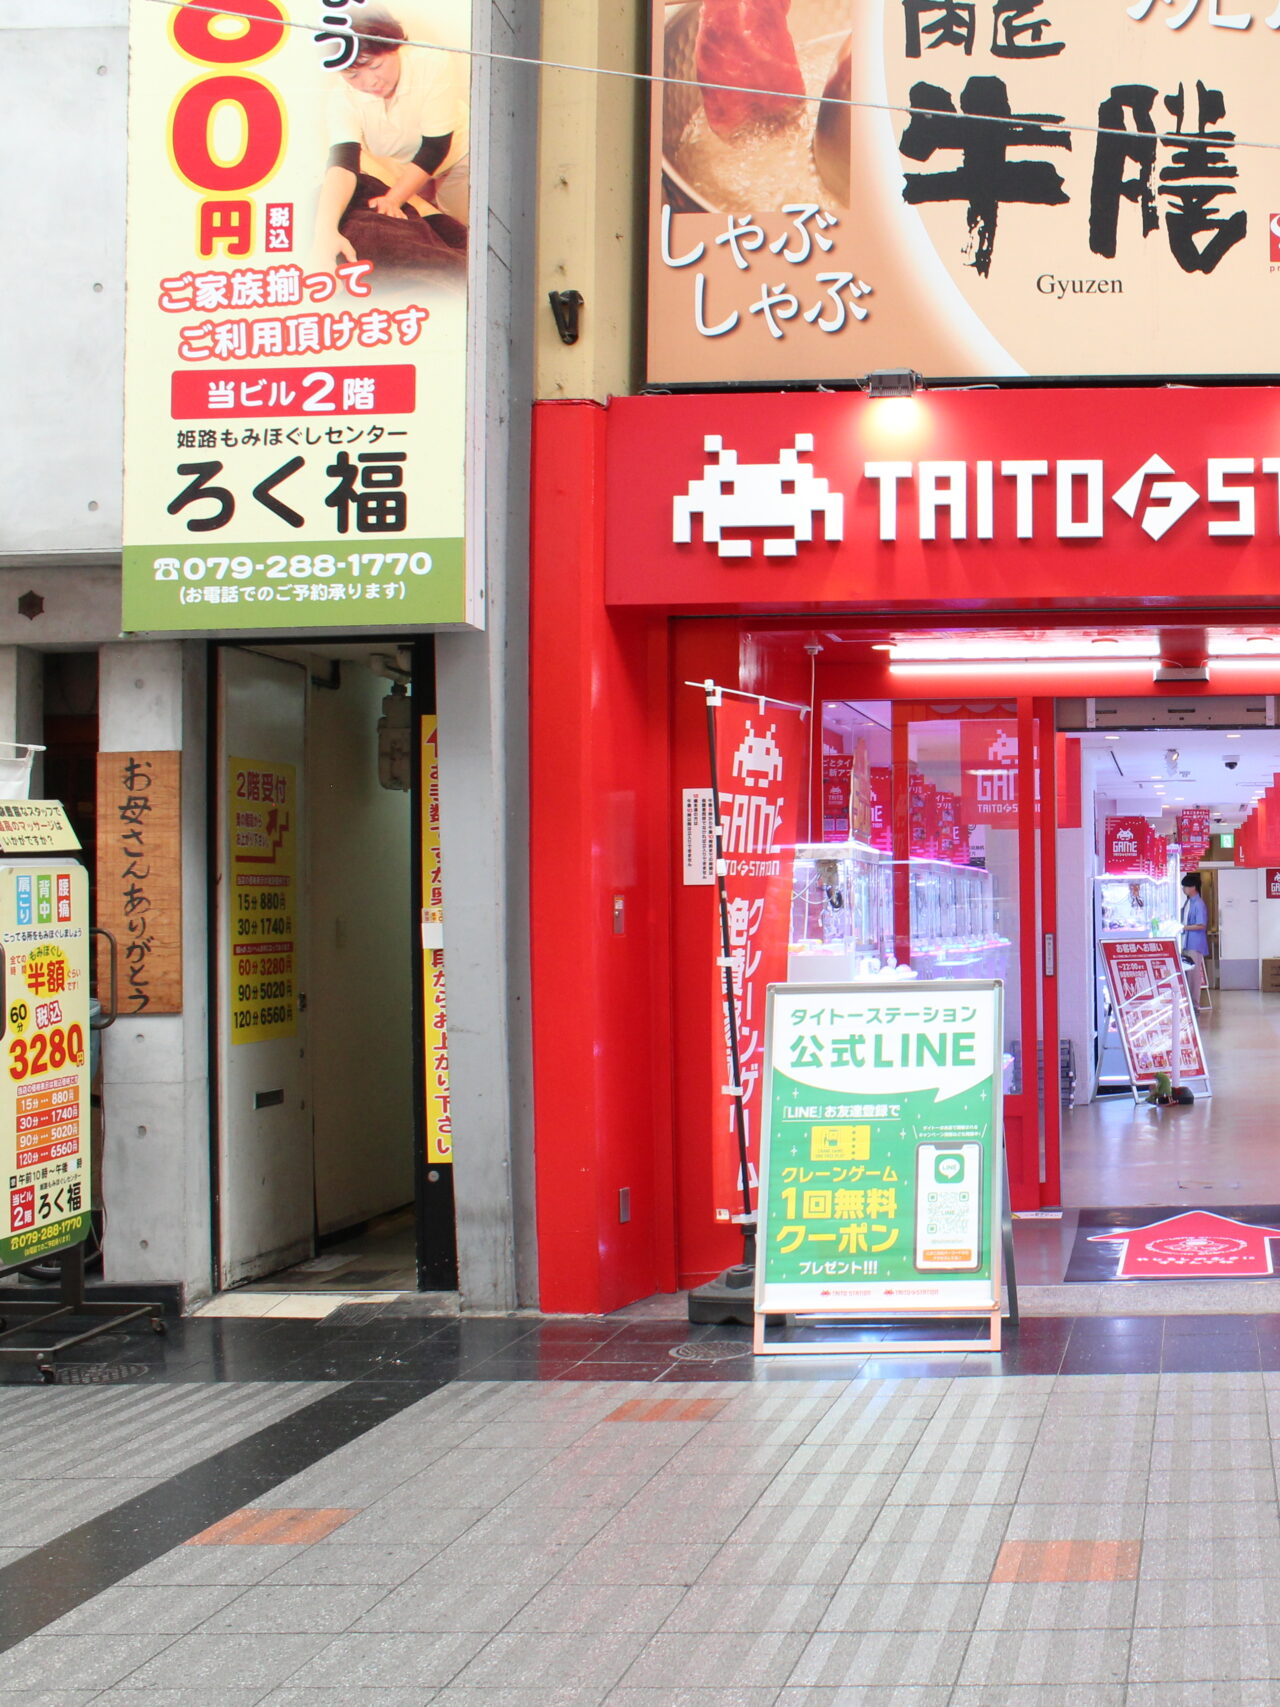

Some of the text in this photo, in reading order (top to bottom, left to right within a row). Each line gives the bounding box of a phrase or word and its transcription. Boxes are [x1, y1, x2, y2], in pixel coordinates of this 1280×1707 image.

[904, 0, 1066, 58] 肉匠
[898, 75, 1247, 279] 牛膳
[268, 206, 290, 250] 税込
[661, 203, 838, 270] しゃぶ
[161, 262, 372, 311] ご家族揃って
[1036, 274, 1124, 299] Gyuzen
[695, 272, 873, 339] しゃぶ
[180, 306, 428, 361] ご利用頂けます
[208, 371, 375, 411] 当ビル2階
[177, 425, 408, 449] 姫路もみほぐしセンター
[167, 451, 407, 534] ろく福
[864, 459, 1104, 541] TAITO
[184, 553, 432, 580] 079-288-1770
[1113, 841, 1138, 852] GAME
[18, 877, 70, 923] 肩こり 背中 腰痛
[117, 757, 152, 1014] お母さんありがとう
[4, 928, 82, 942] こってる所をもみほぐしましょう
[29, 946, 62, 960] もみほぐし
[28, 960, 65, 995] 半額
[36, 1001, 62, 1029] 税込
[790, 1006, 977, 1026] タイトーステーション
[790, 1032, 976, 1068] 公式LINE
[21, 1098, 39, 1111] 15分
[20, 1116, 39, 1130] 30分
[20, 1134, 39, 1147] 90分
[19, 1152, 39, 1165] 120分
[781, 1166, 898, 1183] クレーンゲーム
[12, 1191, 33, 1206] 当ビル
[38, 1182, 81, 1219] ろく福
[781, 1187, 898, 1220] 1回無料
[13, 1206, 32, 1227] 2階
[776, 1223, 899, 1254] クーポン
[799, 1260, 878, 1276] プレゼント!!!
